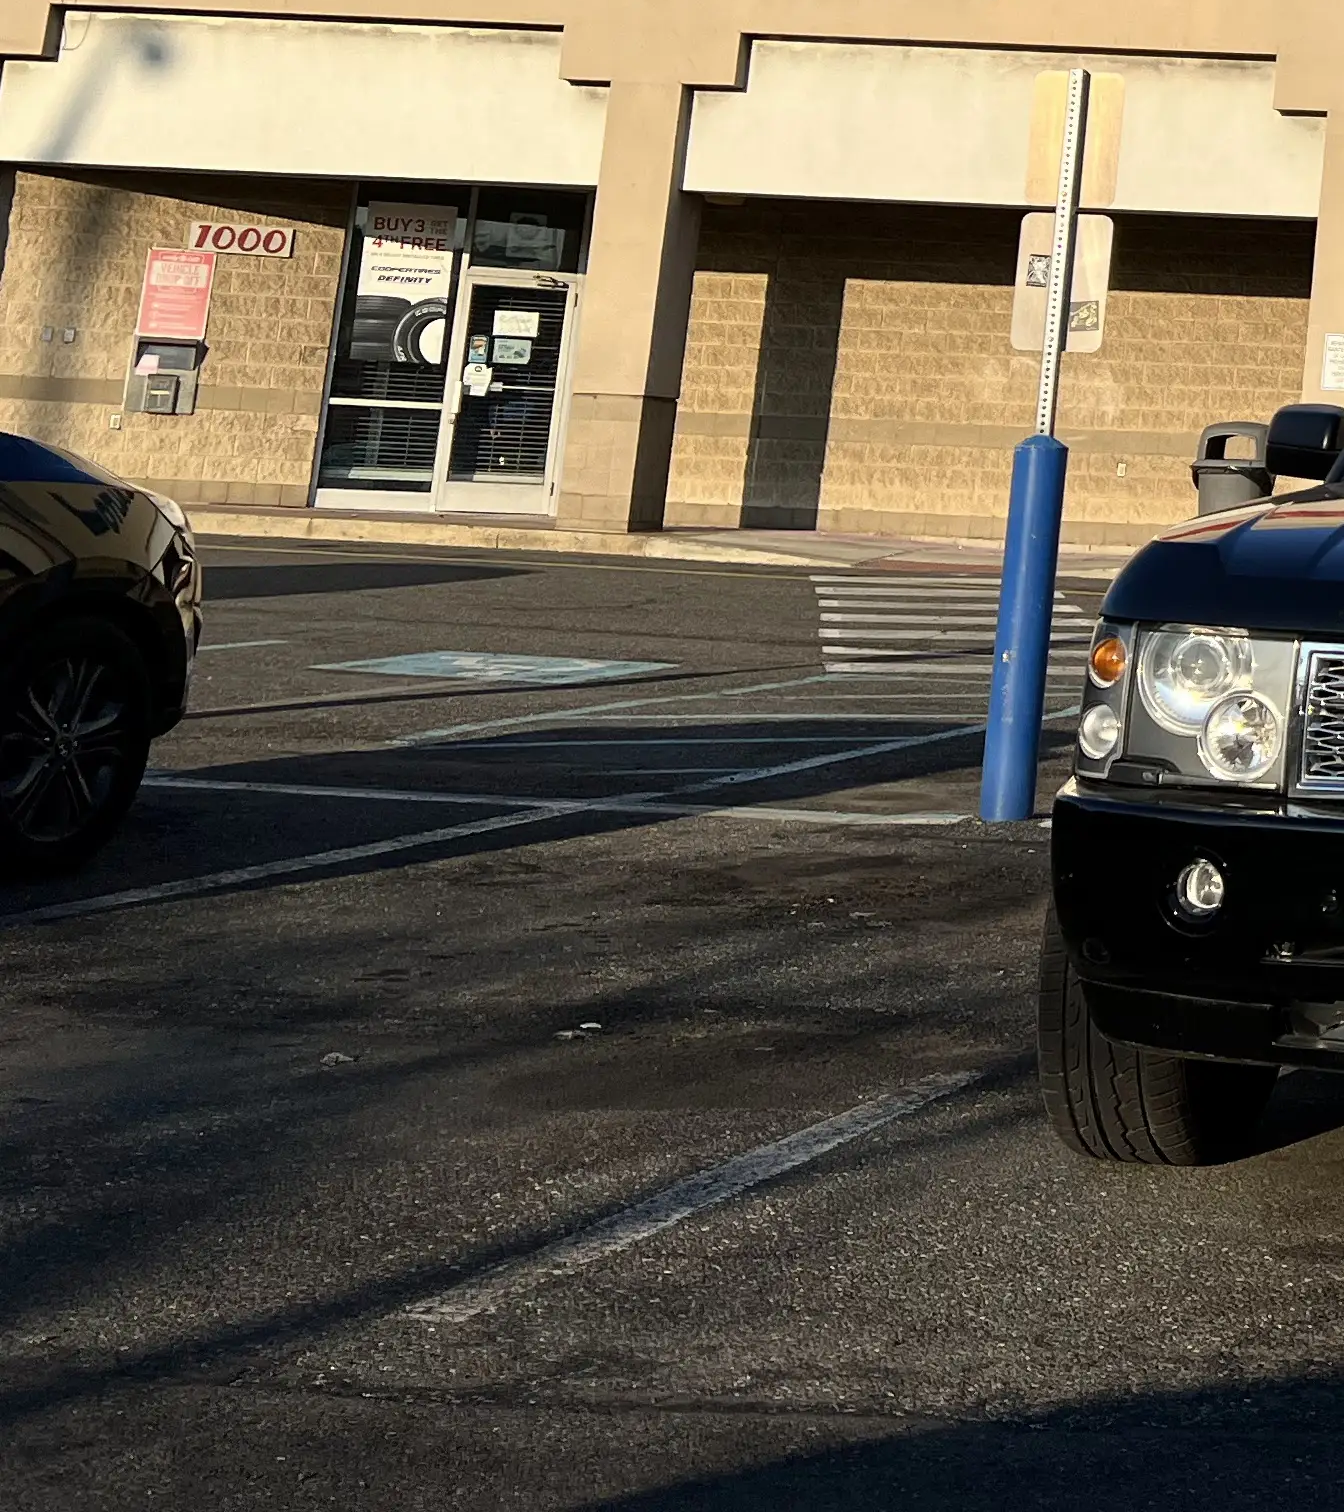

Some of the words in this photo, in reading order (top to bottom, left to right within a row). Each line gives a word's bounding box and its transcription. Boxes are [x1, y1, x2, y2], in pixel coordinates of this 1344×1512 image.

[194, 224, 287, 254] 1000
[400, 236, 447, 251] FREE
[378, 275, 432, 284] DEFINITY
